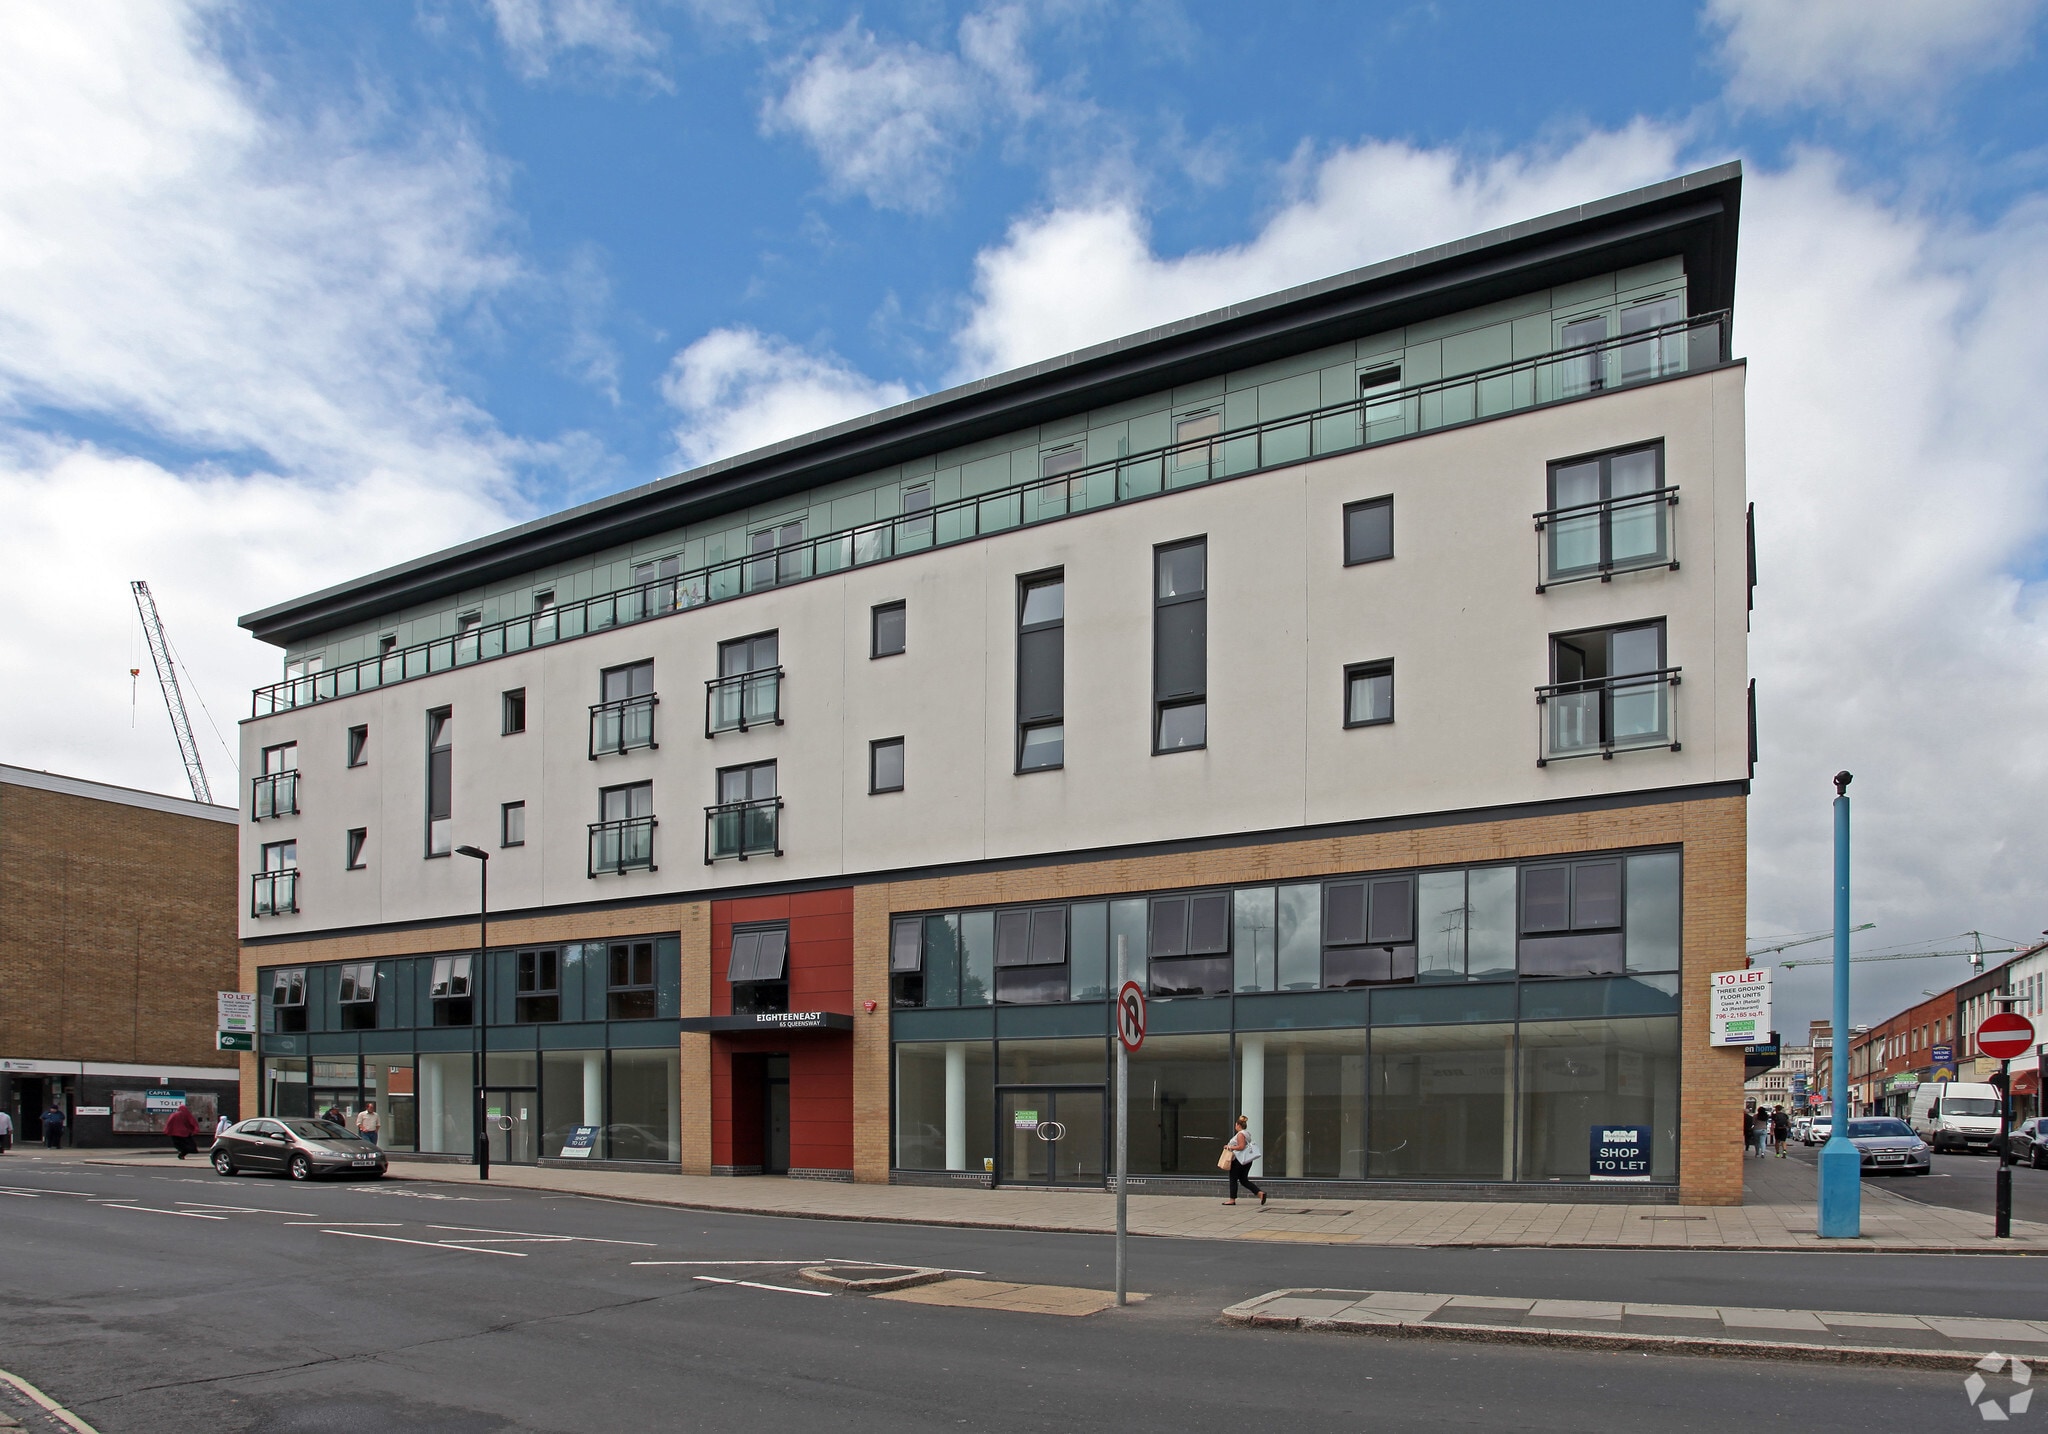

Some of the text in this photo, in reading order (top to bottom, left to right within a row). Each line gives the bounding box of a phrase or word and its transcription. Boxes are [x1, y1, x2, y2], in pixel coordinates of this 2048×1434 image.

[1718, 972, 1764, 985] TO LET
[1738, 985, 1765, 993] GROUND
[756, 1012, 821, 1022] EIGHTEENEAST
[1755, 1044, 1777, 1052] home
[1600, 1148, 1639, 1157] SHOP
[1596, 1160, 1647, 1170] TO LET
